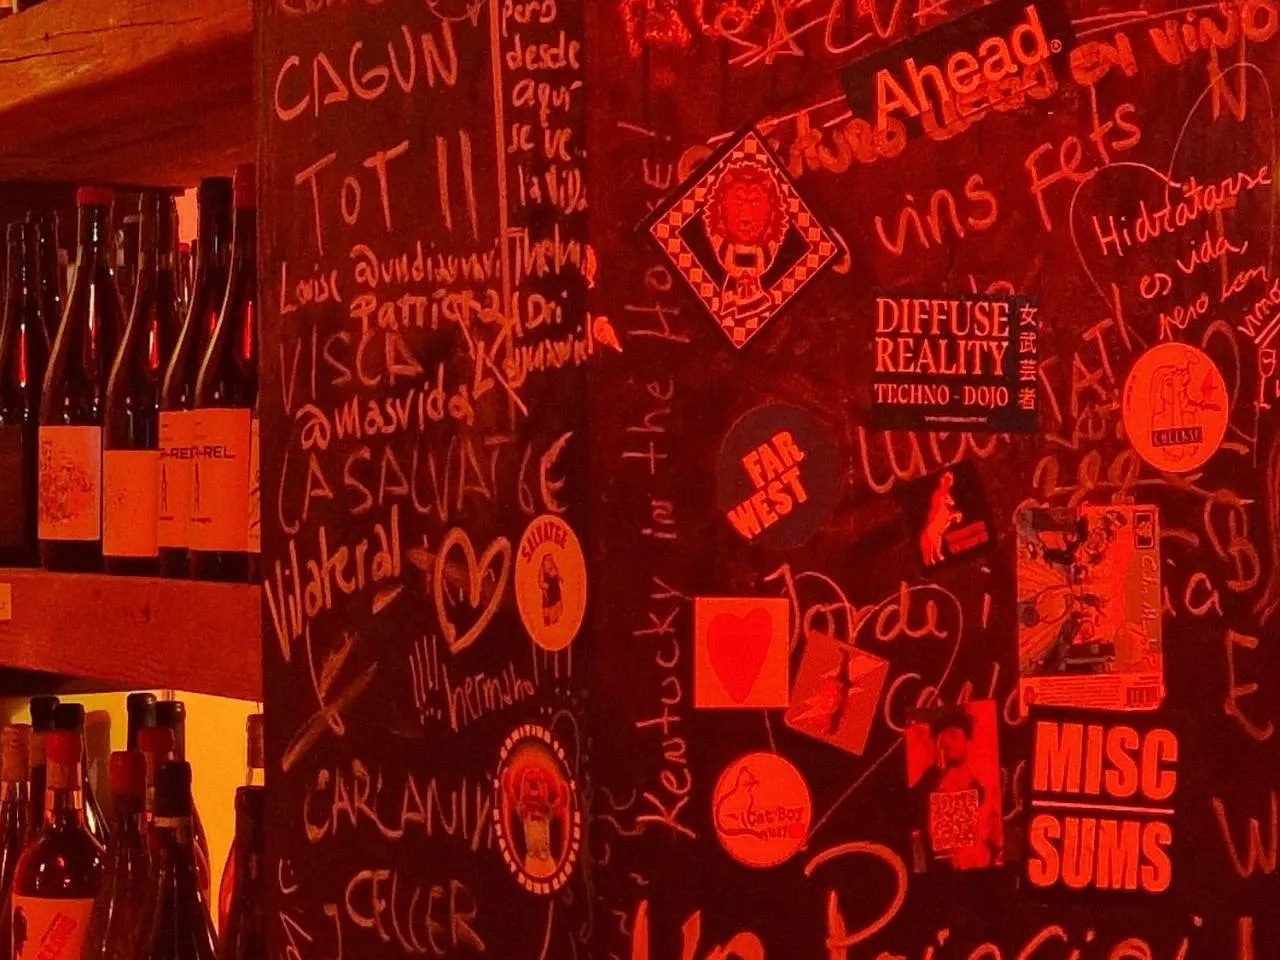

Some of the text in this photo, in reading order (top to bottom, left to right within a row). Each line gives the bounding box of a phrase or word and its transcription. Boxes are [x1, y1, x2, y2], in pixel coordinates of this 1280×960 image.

[274, 23, 458, 122] CAGUN
[505, 29, 581, 71] desde
[875, 2, 1051, 128] Ahead
[294, 139, 411, 257] TOT
[1092, 165, 1273, 256] Hidratarse
[874, 296, 1010, 338] DIFFUSE
[874, 337, 1010, 377] REALITY
[279, 323, 425, 417] VISCA
[873, 382, 951, 406] TECHNO
[962, 384, 1010, 410] DOJO
[740, 430, 806, 490] FAR
[726, 465, 808, 540] WEST
[1031, 720, 1180, 802] MISC
[1026, 813, 1173, 894] SUMS
